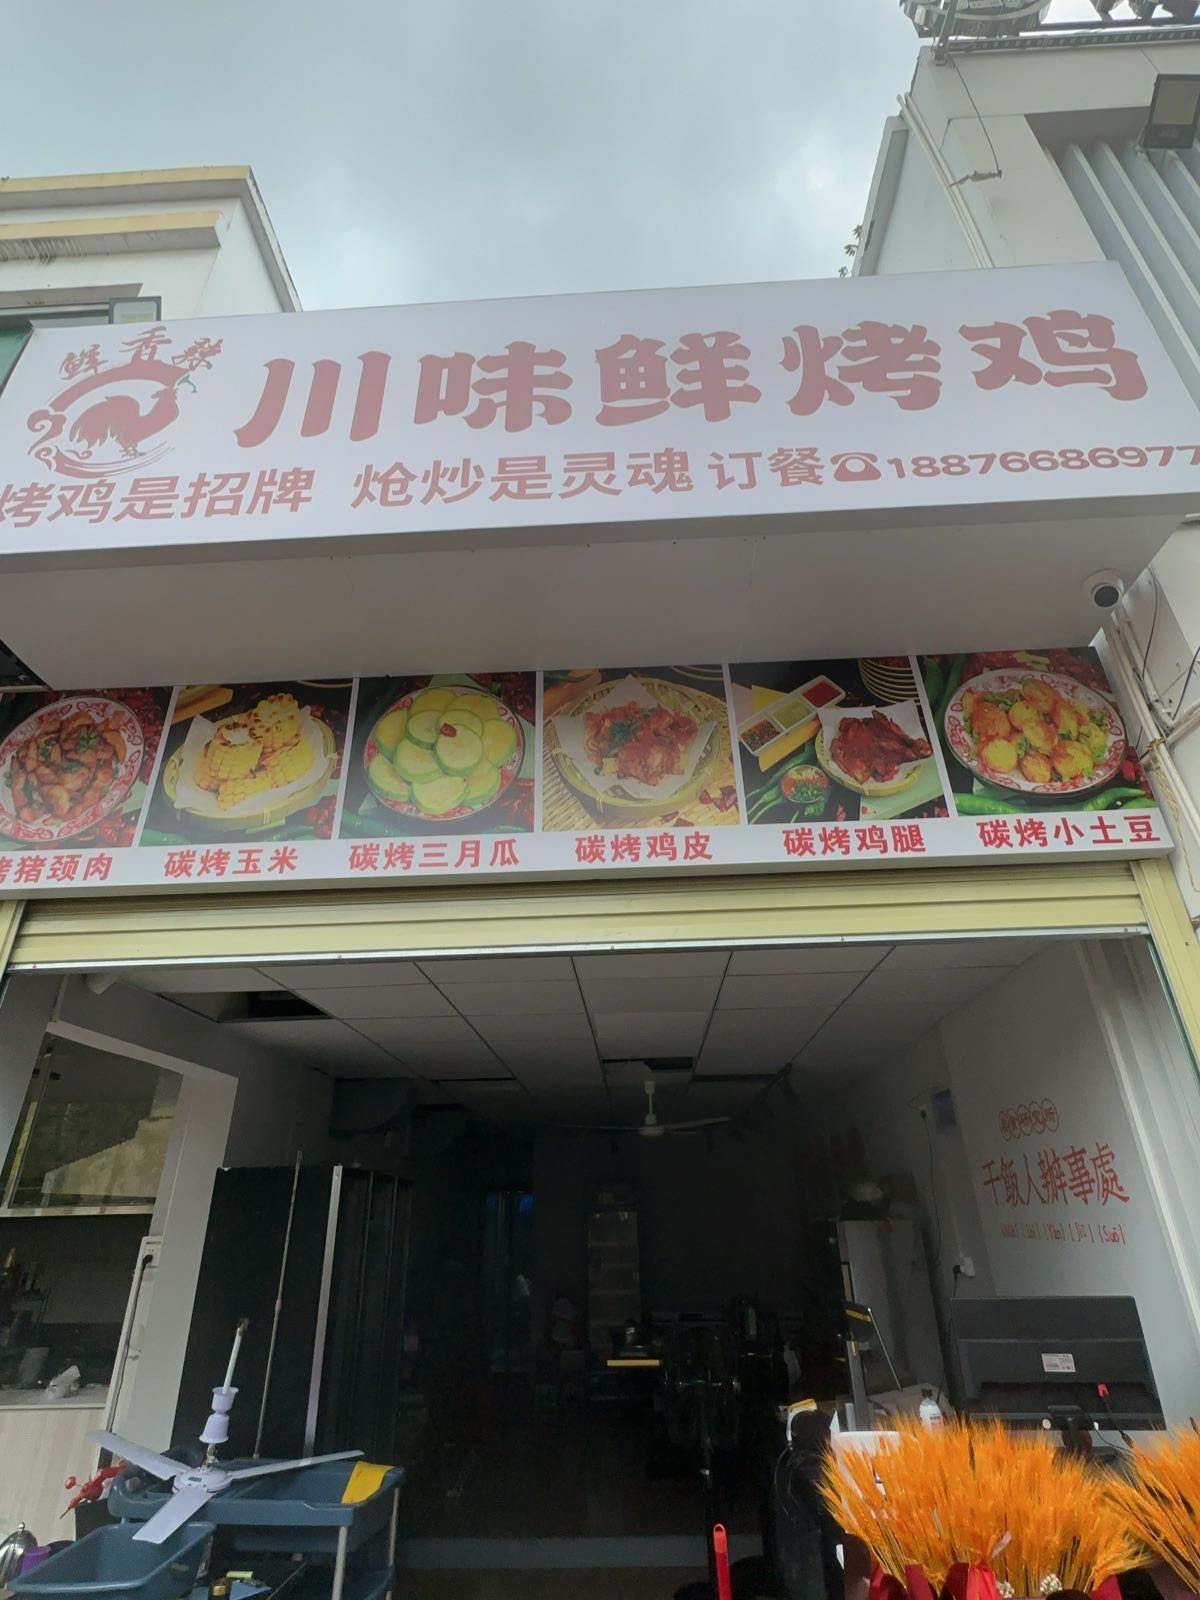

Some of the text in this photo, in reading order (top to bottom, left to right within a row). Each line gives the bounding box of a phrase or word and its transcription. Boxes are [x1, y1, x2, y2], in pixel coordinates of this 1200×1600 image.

[234, 309, 1148, 448] 川味鲜烤鸡
[0, 445, 1200, 528] 烤鸡是招牌 炝炒是灵魂 订餐 18876686977
[575, 830, 713, 864] 碳烤鸡皮
[783, 823, 927, 858] 碳烤鸡腿
[977, 814, 1161, 849] 碳烤小土豆
[164, 846, 299, 878] 碳烤玉米
[349, 838, 520, 871] 碳烤三月瓜
